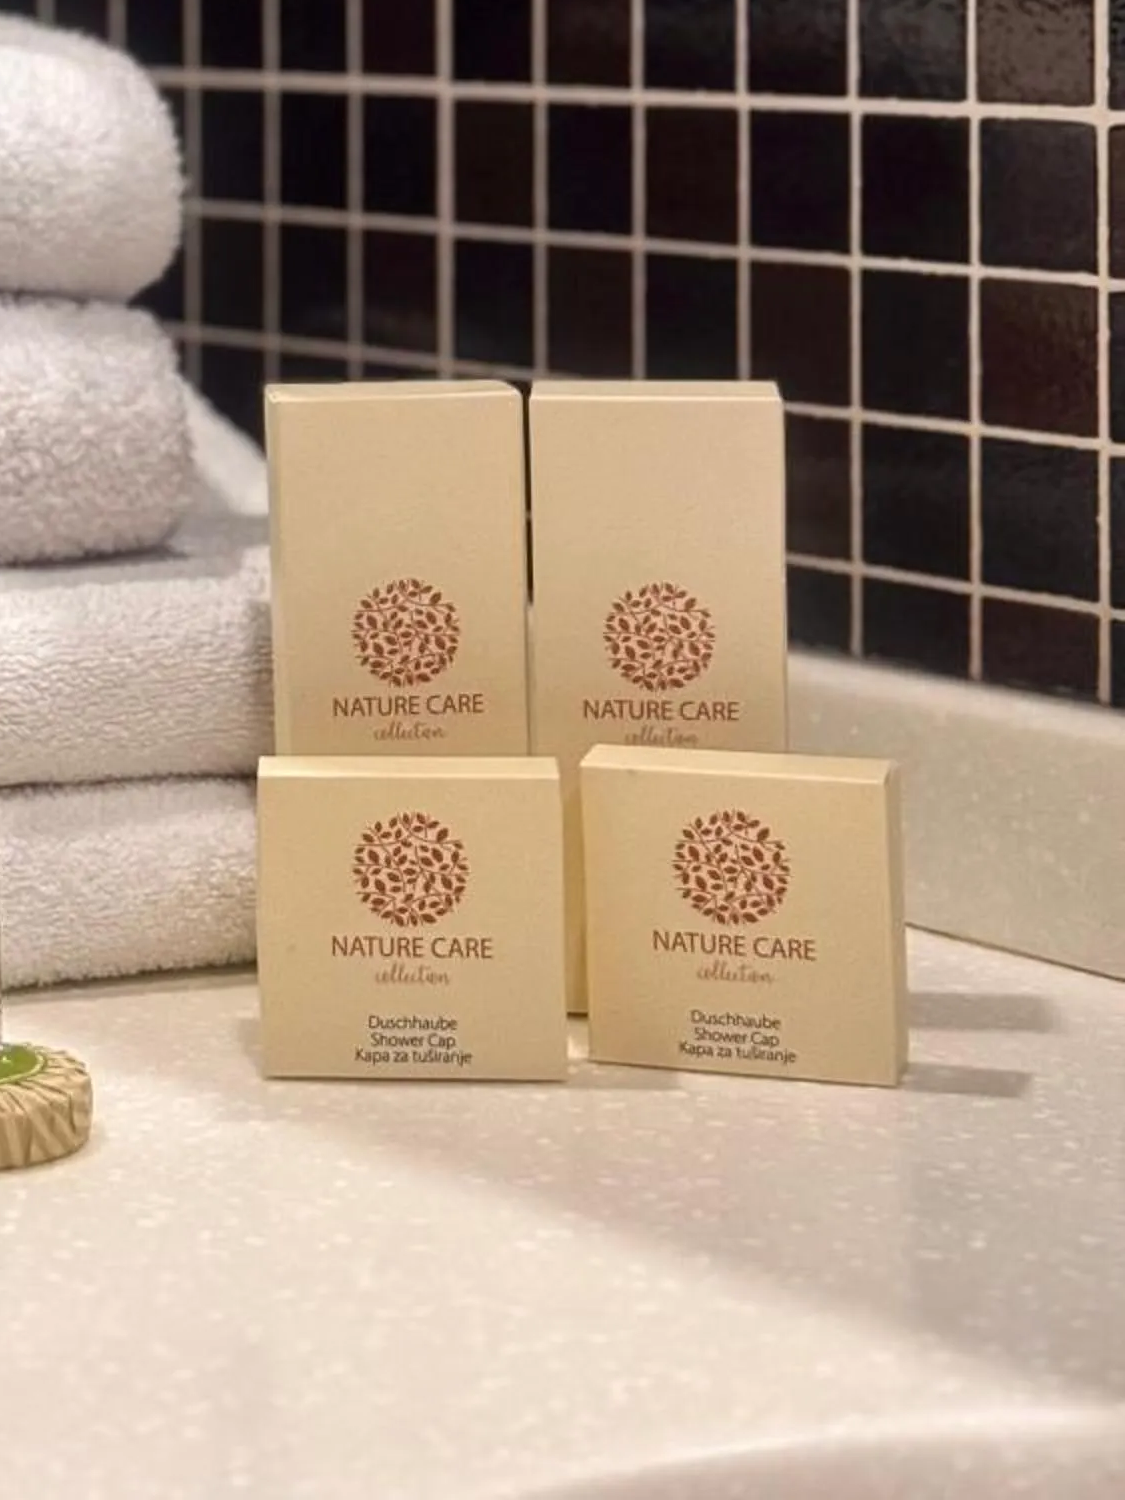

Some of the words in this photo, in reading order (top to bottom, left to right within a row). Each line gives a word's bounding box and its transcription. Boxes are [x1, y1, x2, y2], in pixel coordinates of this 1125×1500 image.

[333, 695, 420, 717] NATURE
[426, 693, 485, 715] CARE
[583, 699, 674, 721] NATURE
[680, 701, 740, 721] CARE
[374, 721, 448, 741] collection
[332, 935, 424, 958] NATURE
[431, 937, 493, 959] CARE
[653, 929, 747, 957] NATURE
[753, 937, 817, 961] CARE
[375, 962, 450, 985] collection
[368, 1014, 458, 1030] Duschhaube
[690, 1009, 782, 1030] Duschhaube
[371, 1032, 423, 1047] Shower
[428, 1033, 456, 1049] Cap
[695, 1027, 748, 1044] Shower
[751, 1032, 779, 1048] Cap
[355, 1049, 390, 1065] Kapa
[393, 1052, 409, 1063] za
[679, 1041, 713, 1058] Kapa
[717, 1046, 732, 1058] za
